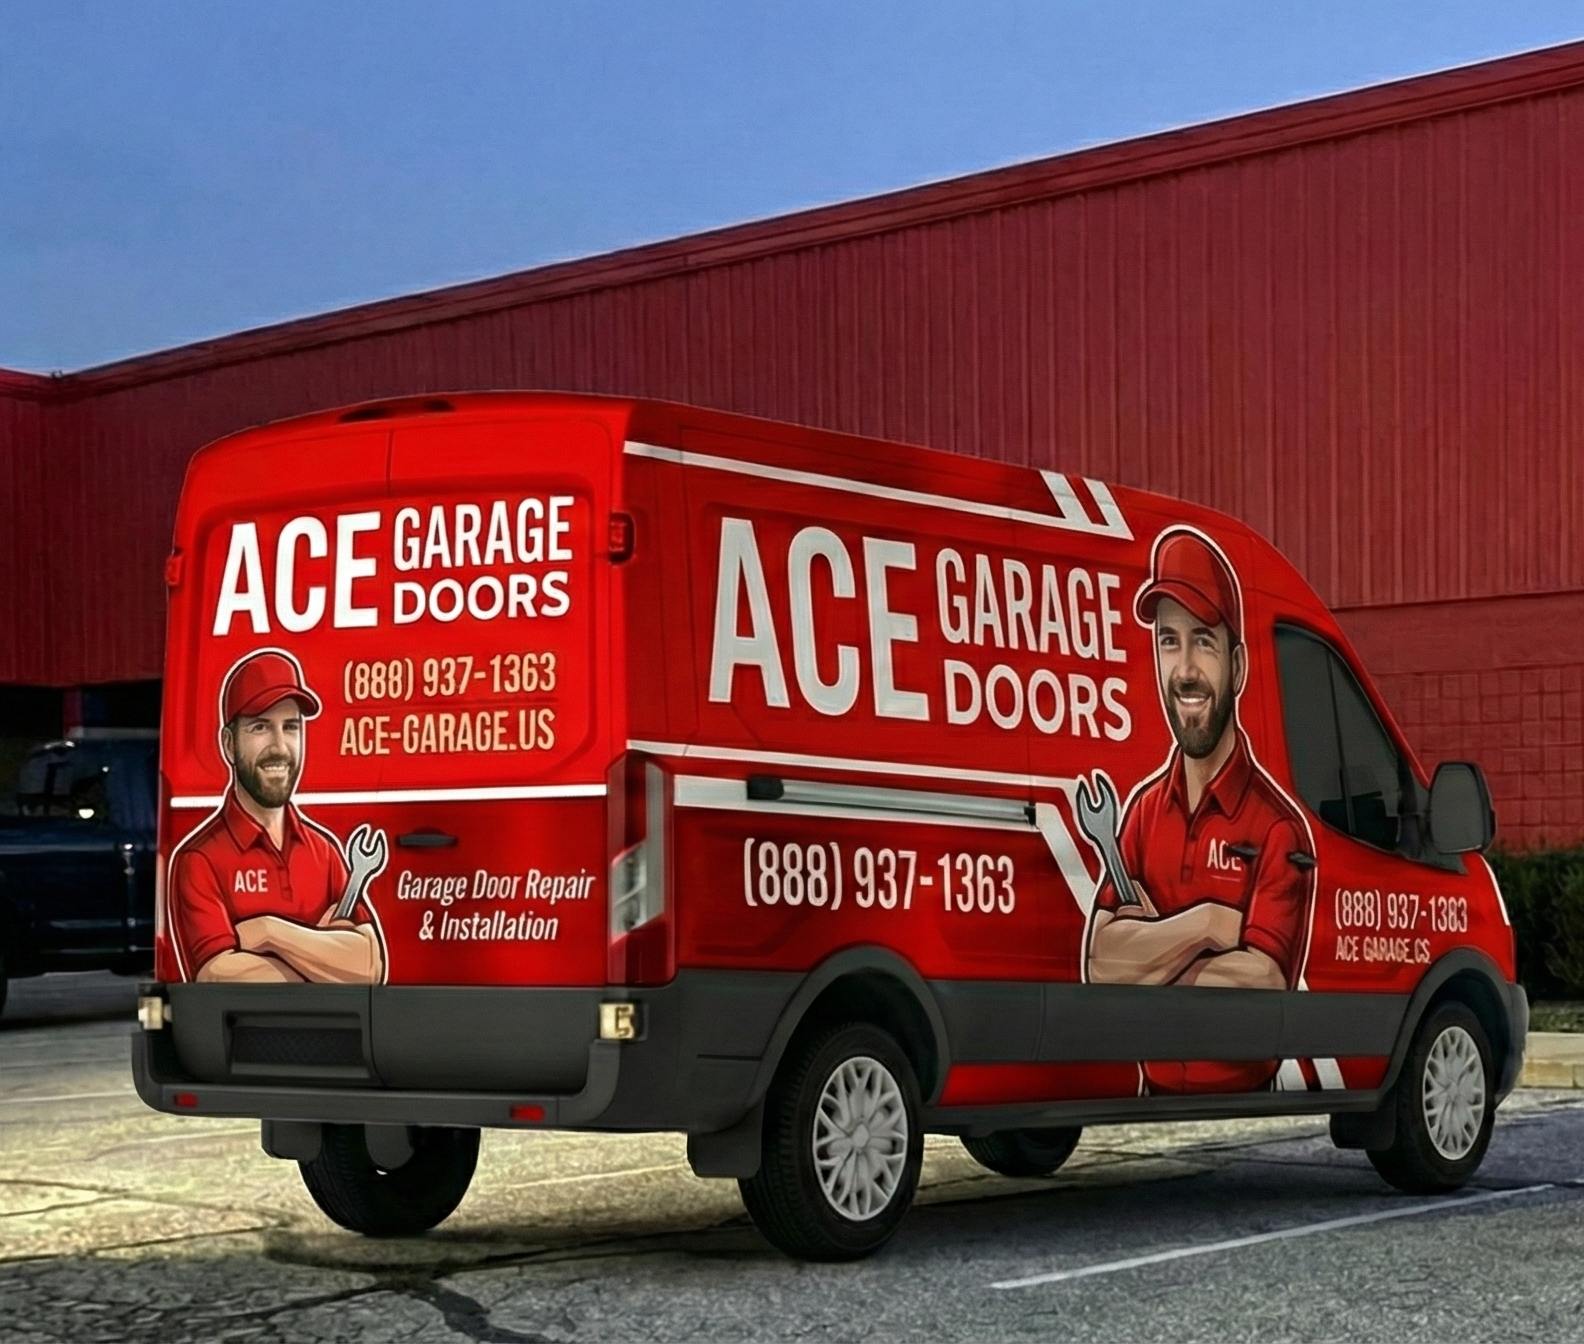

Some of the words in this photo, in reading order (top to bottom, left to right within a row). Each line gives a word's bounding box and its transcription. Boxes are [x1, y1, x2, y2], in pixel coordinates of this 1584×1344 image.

[213, 512, 380, 635] ACE
[394, 496, 574, 571] GARAGE
[394, 571, 569, 624] DOORS
[709, 517, 930, 721] ACE
[936, 548, 1127, 662] GARAGE
[345, 658, 413, 703] (888)
[423, 652, 555, 696] 937-1363
[944, 659, 1131, 741] DOORS
[341, 709, 554, 755] ACE-GARAGE.US
[235, 870, 268, 892] ACE
[398, 870, 467, 906] Garage
[472, 870, 521, 899] Door
[525, 869, 595, 904] Repair
[744, 838, 842, 910] (888)
[854, 847, 1015, 913] 937-1363
[419, 911, 433, 940] &
[441, 911, 558, 940] Installation
[1335, 889, 1381, 930] (888)
